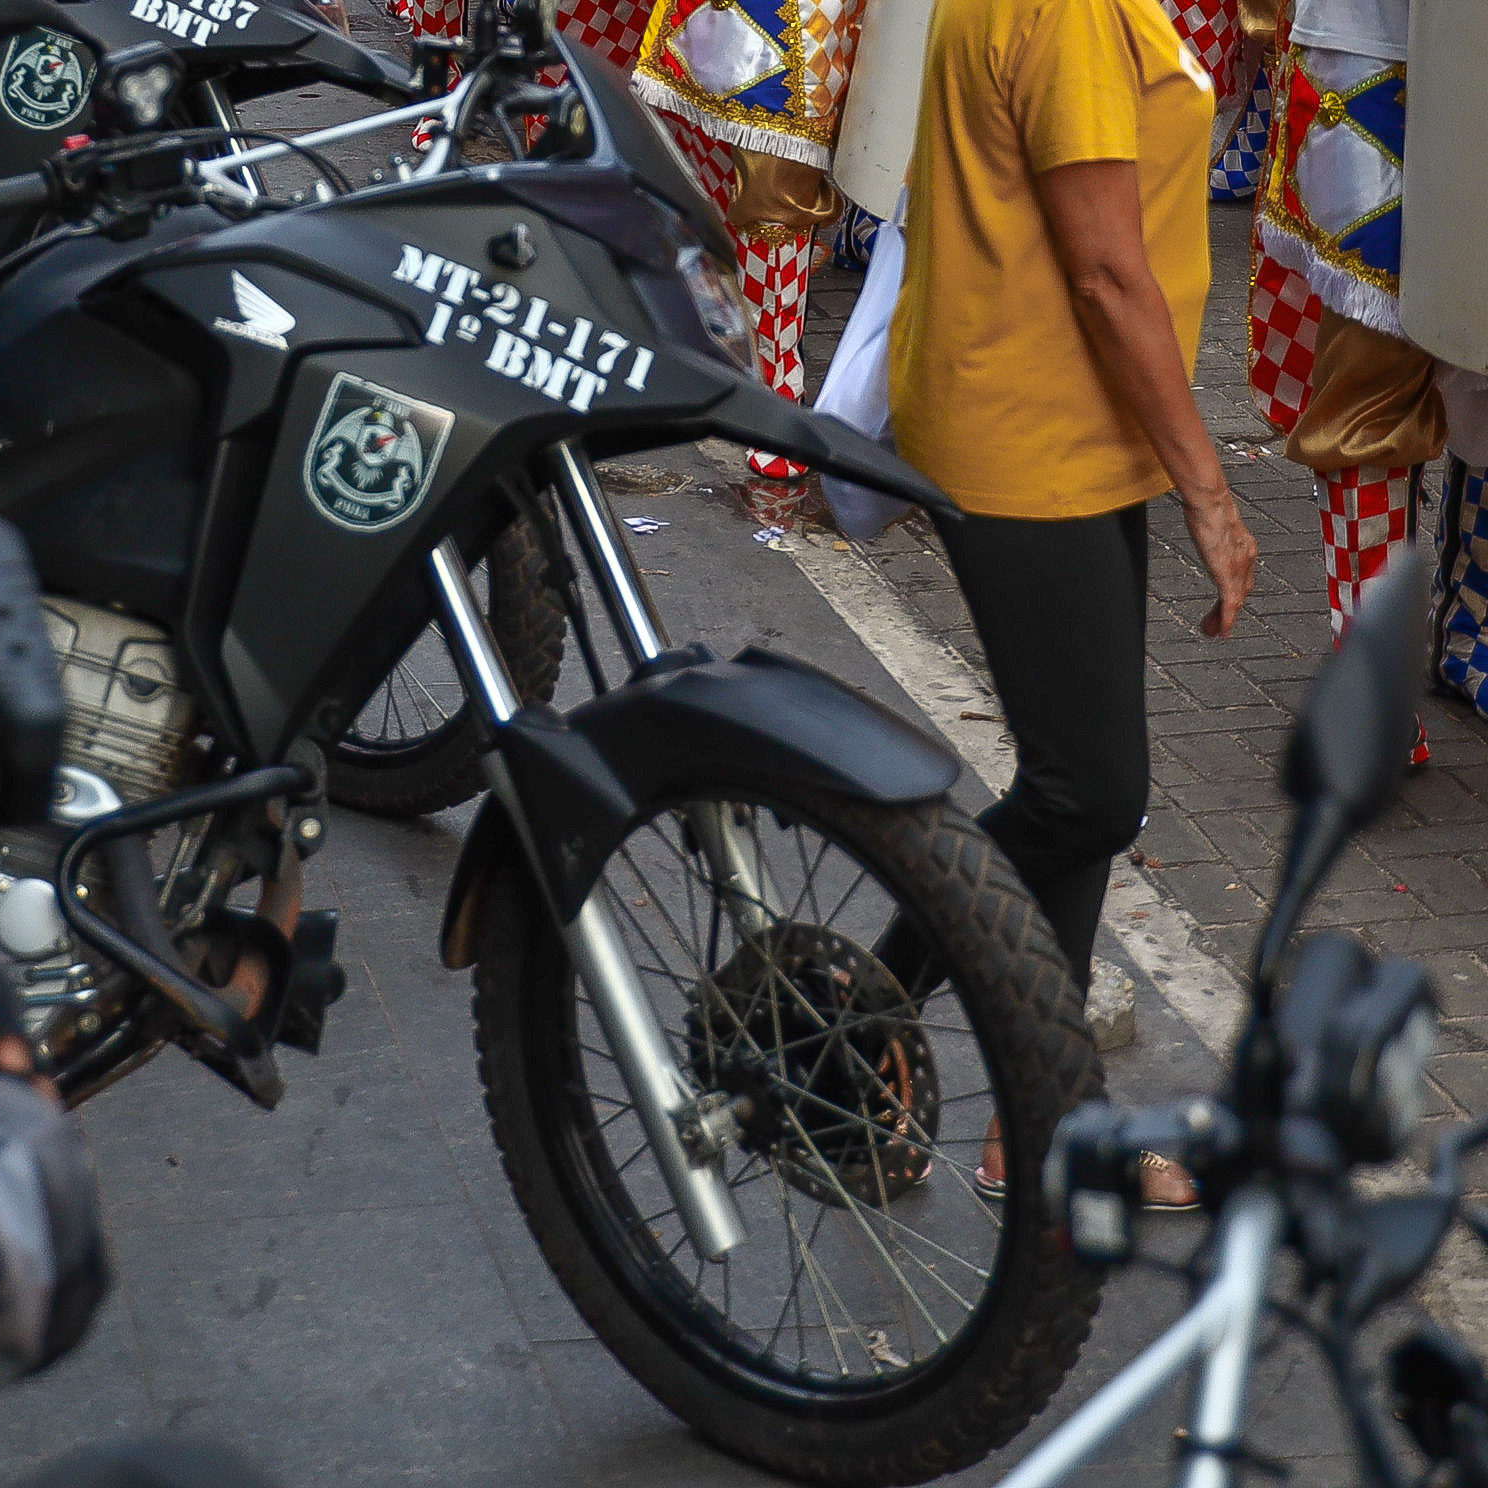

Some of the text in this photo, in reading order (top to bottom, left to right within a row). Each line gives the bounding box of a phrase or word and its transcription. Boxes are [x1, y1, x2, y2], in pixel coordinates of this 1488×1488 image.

[391, 243, 655, 392] MT-21-171
[426, 301, 608, 414] 1º BMT
